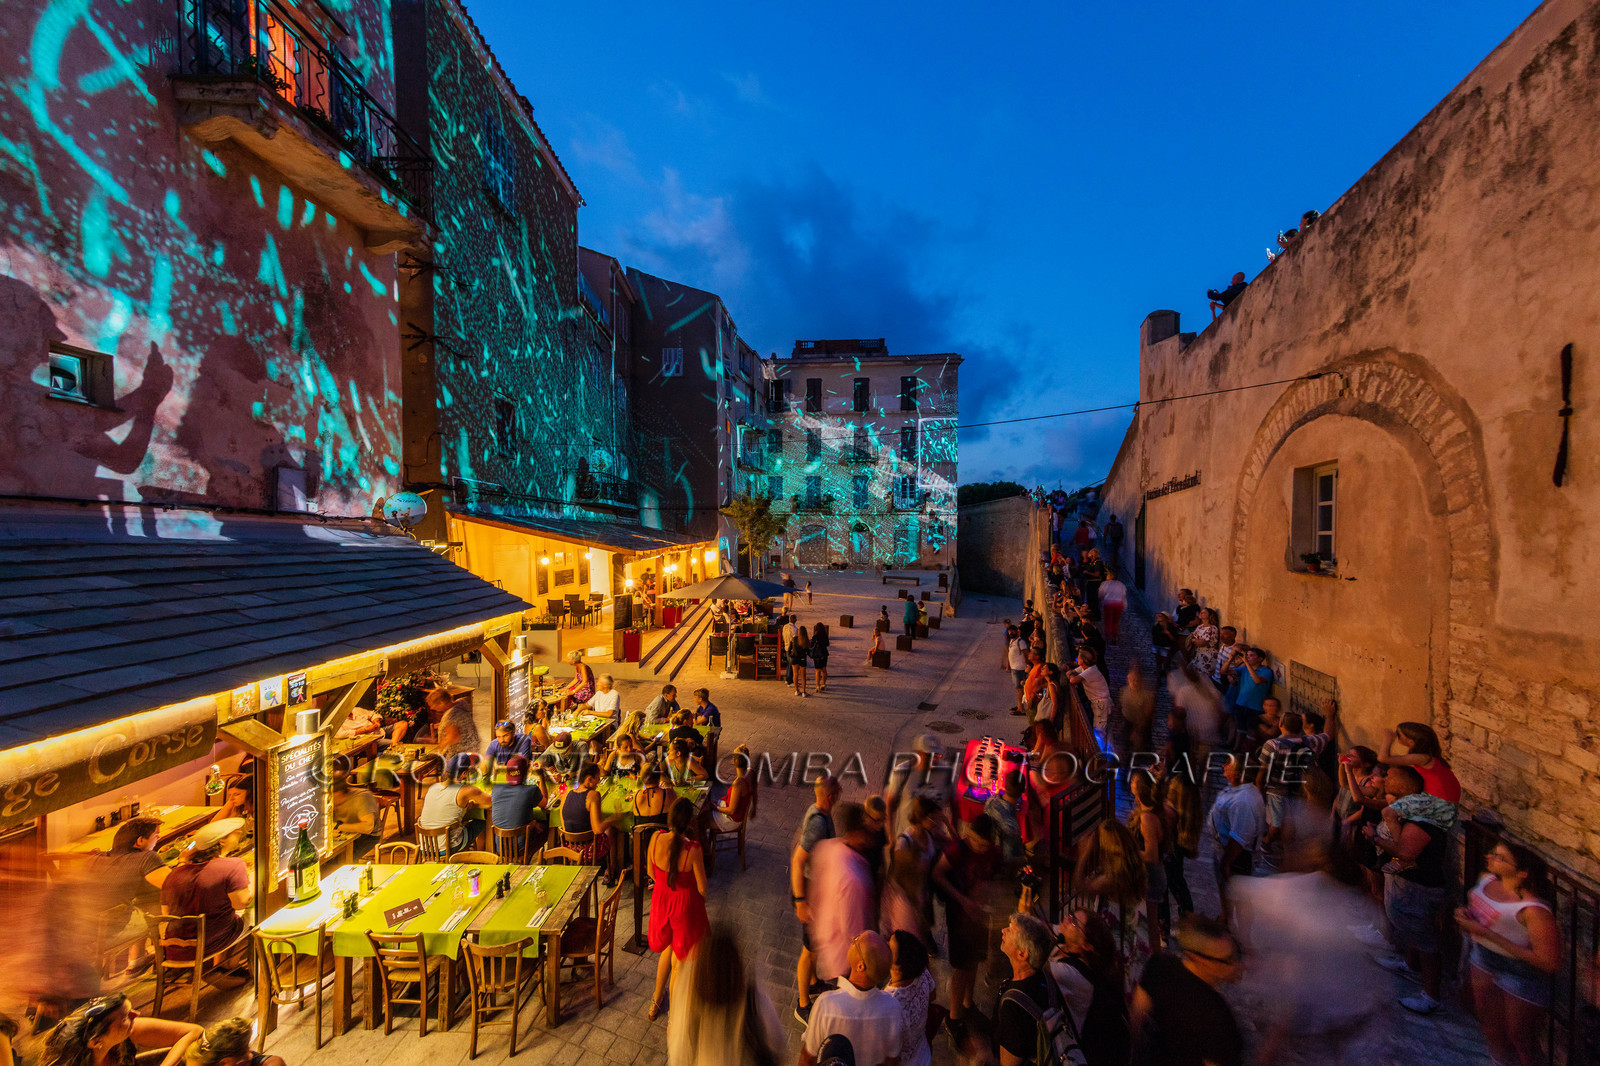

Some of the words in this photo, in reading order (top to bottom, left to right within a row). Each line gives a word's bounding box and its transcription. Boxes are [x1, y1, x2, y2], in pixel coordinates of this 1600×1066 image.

[88, 724, 204, 784] Corse
[281, 740, 322, 763] SPÉCIALITÉS
[284, 761, 296, 772] DU
[298, 752, 316, 766] CHEF
